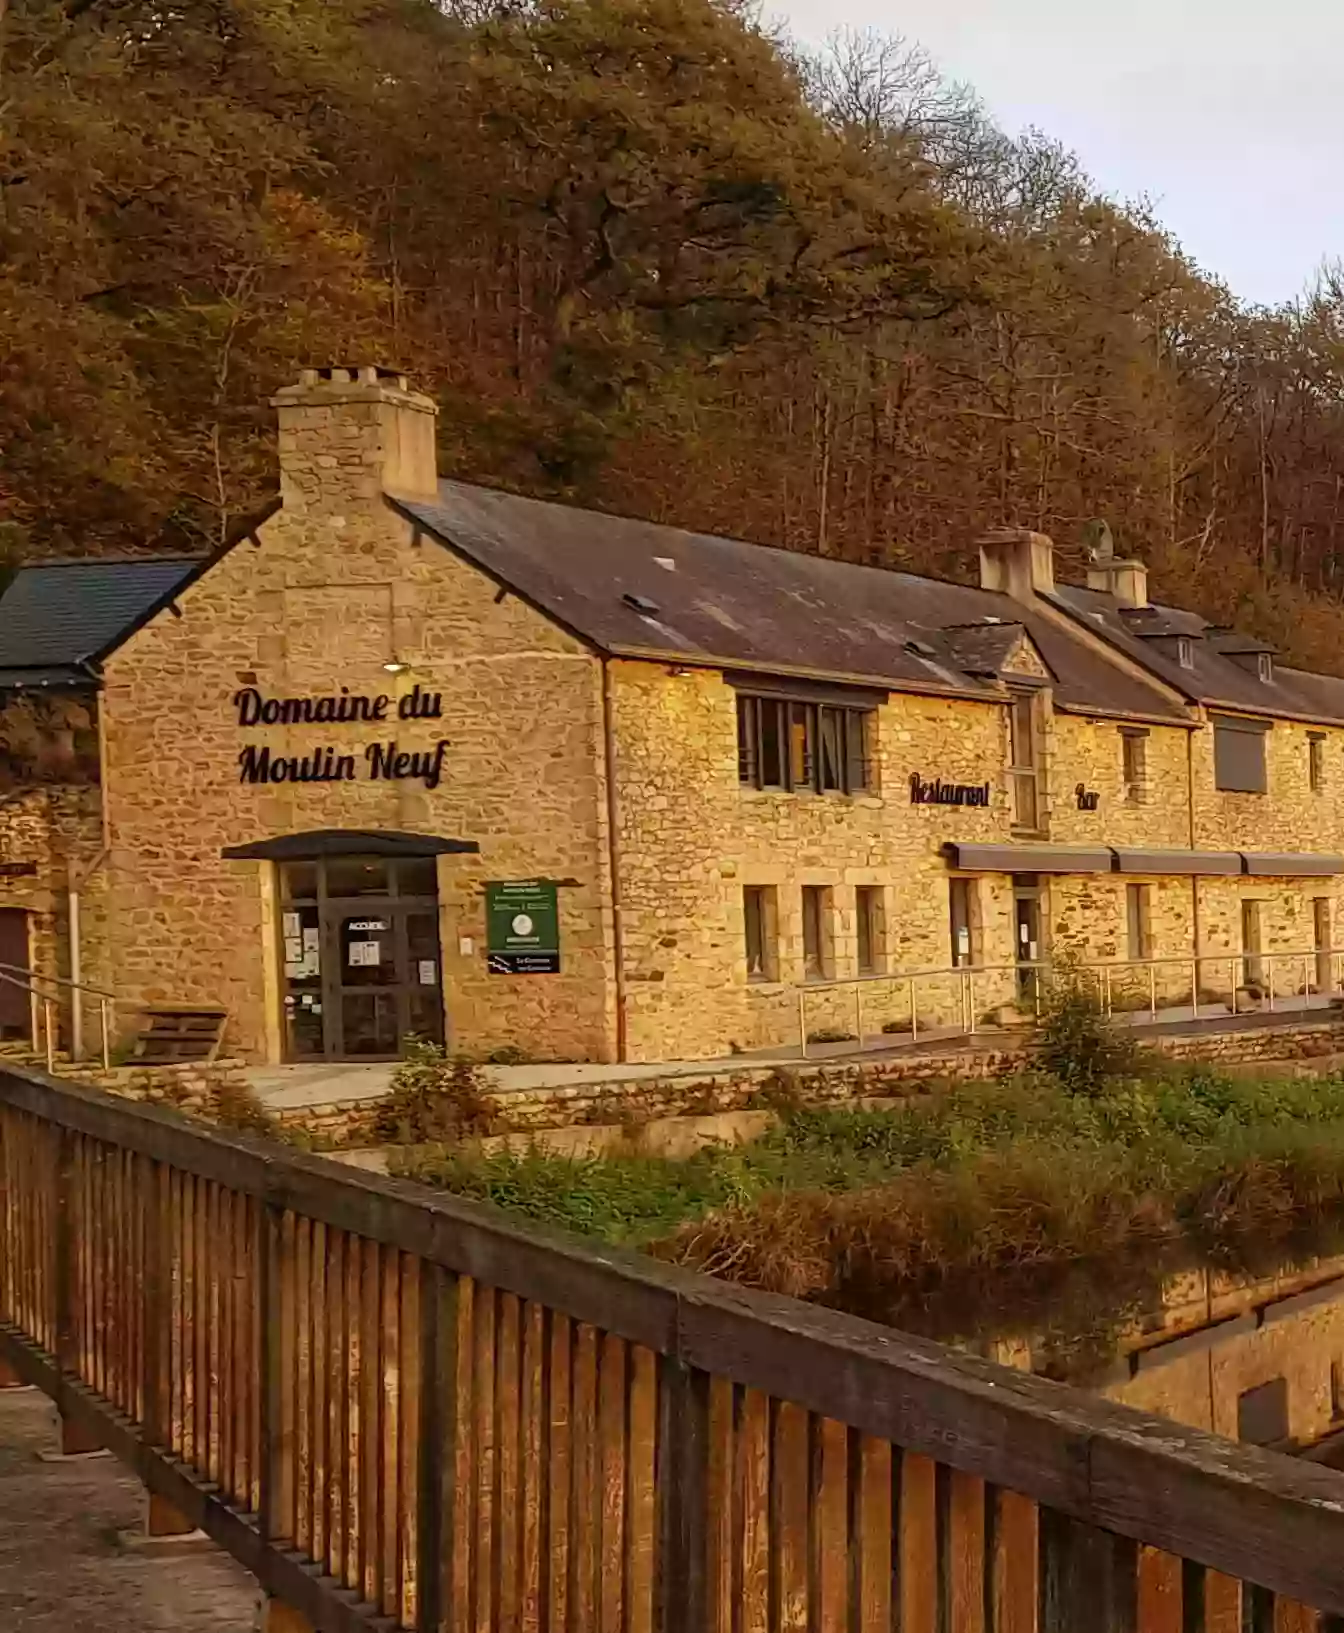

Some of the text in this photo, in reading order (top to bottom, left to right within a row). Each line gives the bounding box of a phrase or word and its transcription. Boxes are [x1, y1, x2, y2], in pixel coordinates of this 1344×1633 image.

[234, 684, 442, 726] Domaine du
[239, 739, 449, 789] Moulin Neuf
[908, 771, 989, 807] Restaurant
[1075, 783, 1100, 810] Bar
